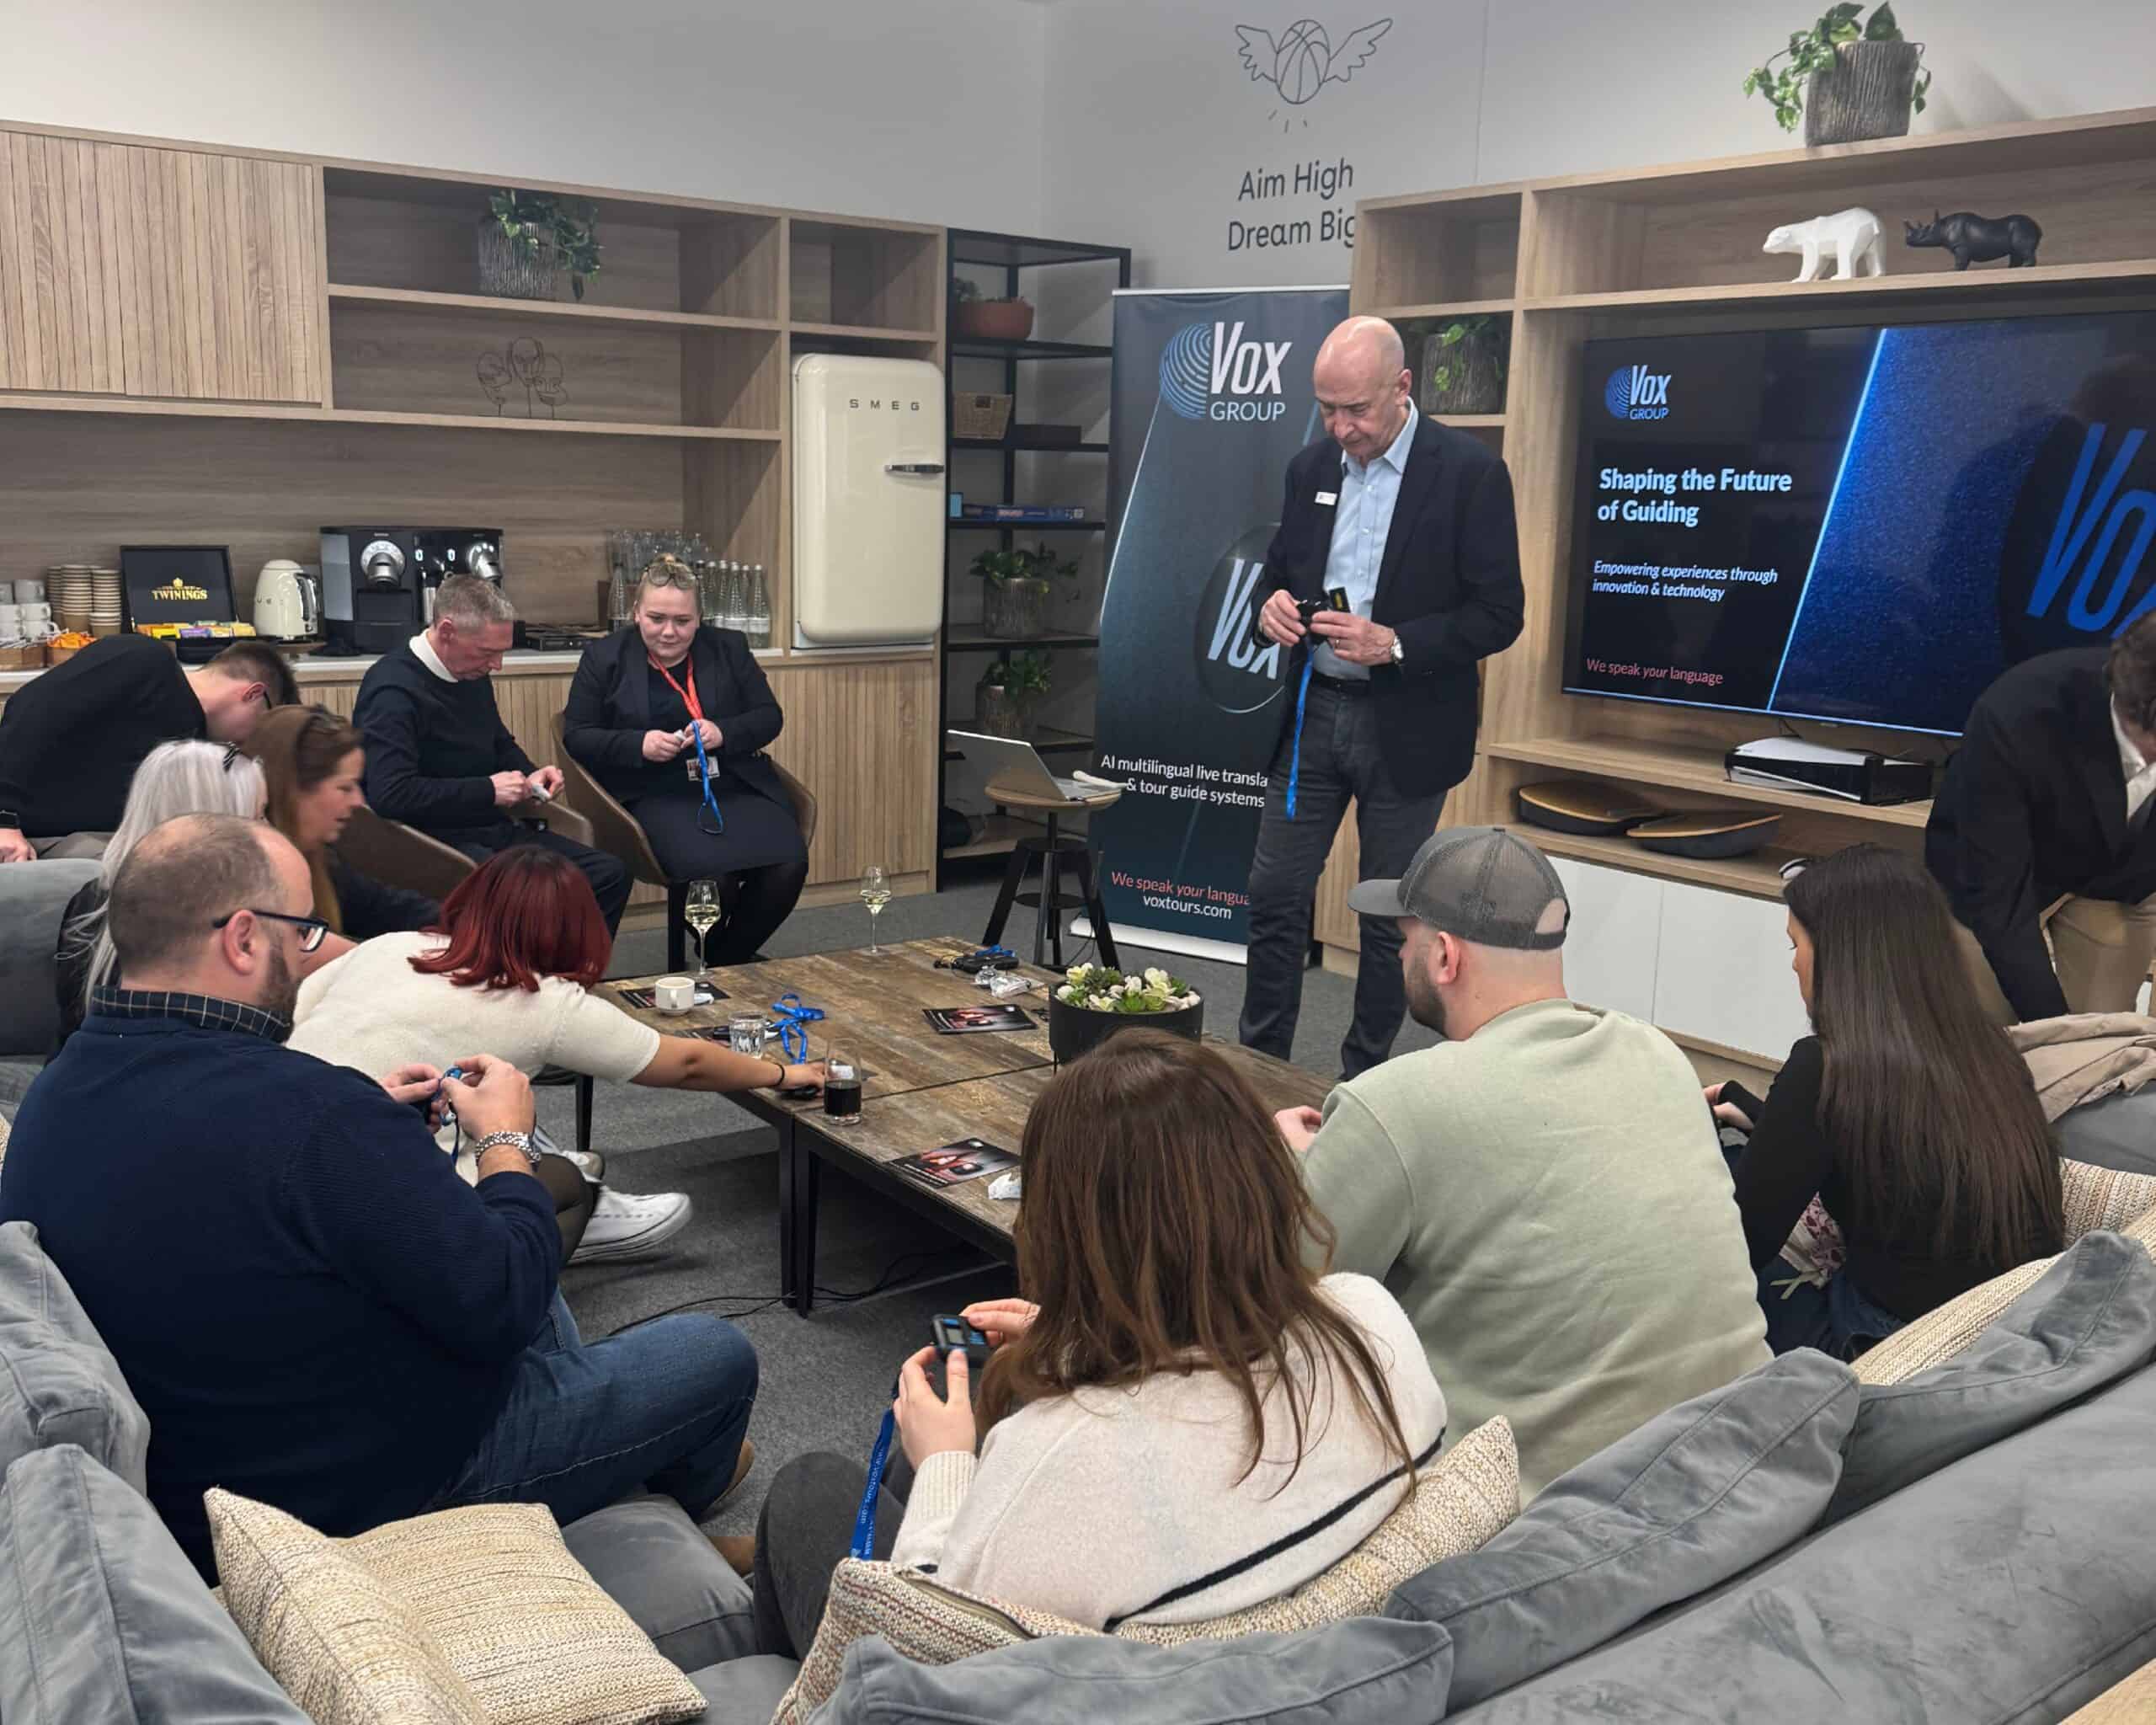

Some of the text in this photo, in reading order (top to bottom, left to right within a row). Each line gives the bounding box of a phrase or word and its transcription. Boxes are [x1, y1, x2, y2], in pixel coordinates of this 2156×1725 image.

[1238, 158, 1353, 200] Aim High
[1228, 209, 1354, 250] Dream Big
[849, 398, 920, 411] SMEG
[1210, 401, 1286, 421] GROUP
[1630, 408, 1669, 419] GROUP
[1599, 467, 1793, 494] Shaping the Future
[1598, 499, 1700, 527] of Guiding
[2025, 424, 2156, 638] Vo
[1593, 560, 1779, 585] Empowering experiences through
[152, 590, 208, 601] TWININGS
[1593, 578, 1725, 601] innovation & technology
[1587, 658, 1723, 686] We speak your language
[1100, 754, 1267, 787] AI multilingual live transla
[1127, 777, 1265, 808] & tour guide systems
[1111, 871, 1134, 887] We
[1136, 879, 1173, 894] speak
[1177, 884, 1206, 898] your
[1143, 895, 1232, 920] voxtours.com
